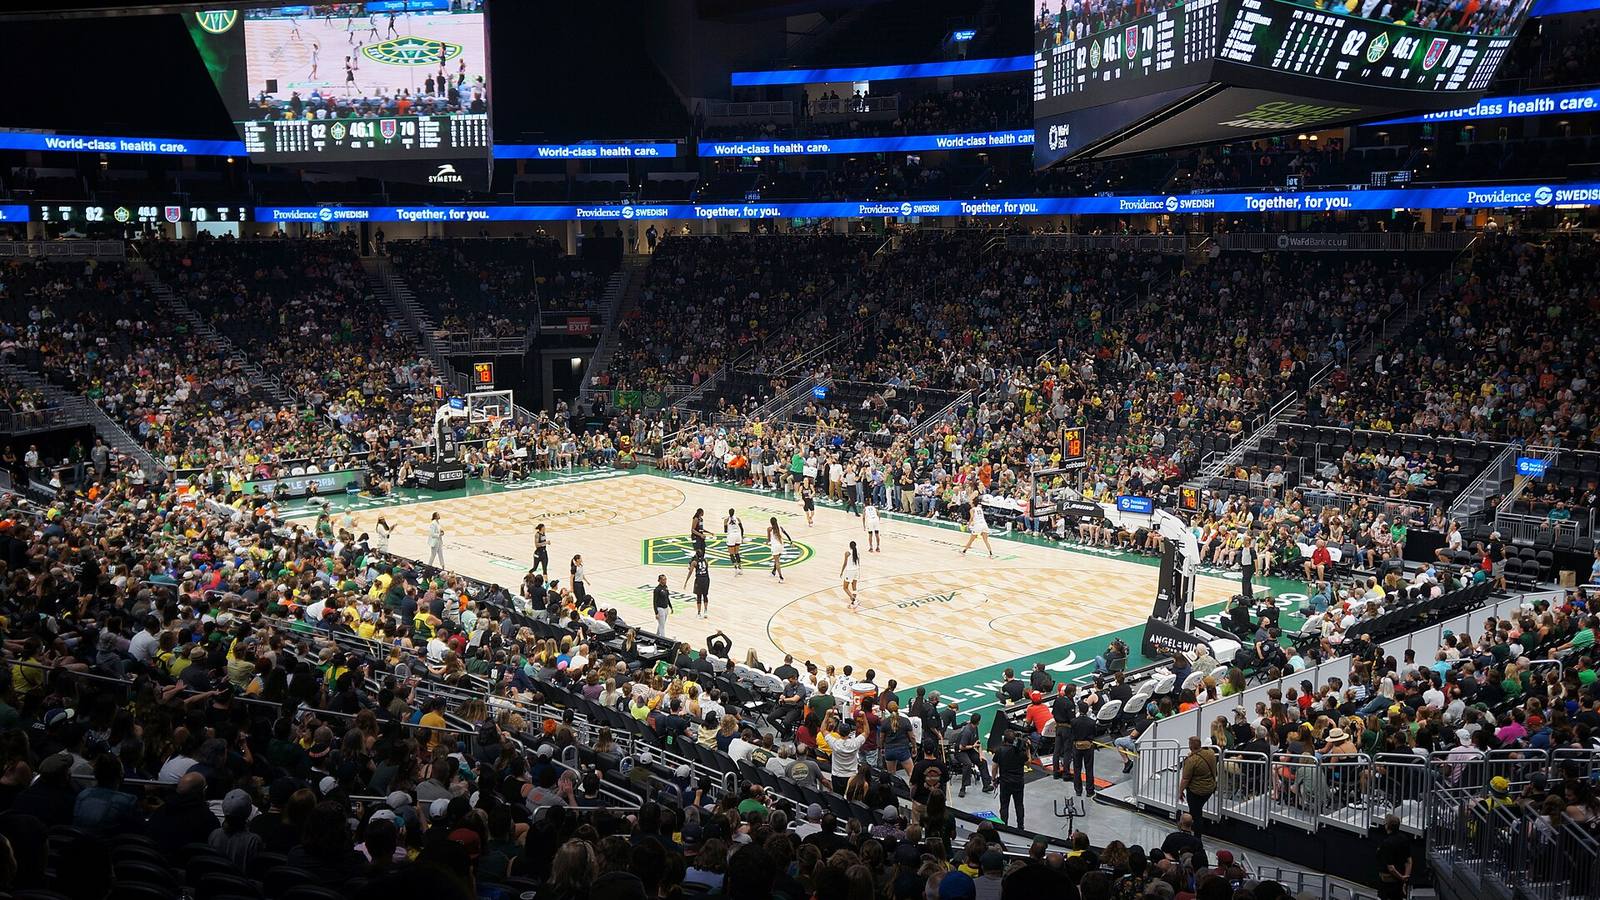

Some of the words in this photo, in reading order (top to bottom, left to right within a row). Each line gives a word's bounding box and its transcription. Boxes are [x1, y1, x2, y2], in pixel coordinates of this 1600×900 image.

[1076, 46, 1087, 70] 82
[1103, 33, 1122, 62] 46.1
[1141, 25, 1154, 51] 70
[1341, 30, 1366, 56] 82
[1391, 36, 1420, 60] 46.1
[1441, 45, 1461, 68] 70
[1508, 97, 1555, 113] health
[1560, 96, 1597, 110] care.
[311, 124, 326, 138] 82
[350, 122, 374, 137] 46.1
[400, 121, 415, 136] 70
[45, 137, 116, 150] World-class
[120, 140, 156, 151] health
[160, 143, 187, 152] care.
[936, 136, 986, 147] World-class
[989, 133, 1015, 144] health
[538, 147, 597, 157] World-class
[600, 146, 631, 156] health
[634, 147, 658, 156] care.
[714, 144, 770, 155] World-class
[773, 143, 804, 153] health
[807, 144, 831, 152] care.
[429, 175, 462, 183] SYMETRA
[1467, 190, 1531, 203] Providence
[859, 204, 899, 214] Providence
[913, 205, 940, 213] SWEDISH
[961, 202, 1002, 215] Together,
[1004, 202, 1018, 213] for
[1019, 204, 1038, 215] you.
[1119, 199, 1164, 210] Providence
[1179, 199, 1215, 208] SWEDISH
[1245, 196, 1301, 211] Together,
[1305, 196, 1323, 208] for
[1324, 198, 1352, 210] you.
[86, 207, 104, 221] 82
[190, 208, 206, 221] 70
[273, 210, 317, 220] Providence
[334, 211, 369, 219] SWEDISH
[397, 209, 446, 221] Together,
[449, 209, 465, 219] for
[467, 211, 489, 221] you.
[576, 208, 620, 217] Providence
[636, 208, 668, 216] SWEDISH
[695, 207, 740, 218] Together,
[744, 207, 758, 216] for
[760, 209, 780, 218] you.
[481, 371, 491, 382] 18
[262, 481, 303, 493] SELE
[305, 478, 335, 491] ORM
[897, 591, 962, 609] Alaska
[1150, 634, 1177, 648] ANGEL
[1182, 642, 1210, 656] WIS
